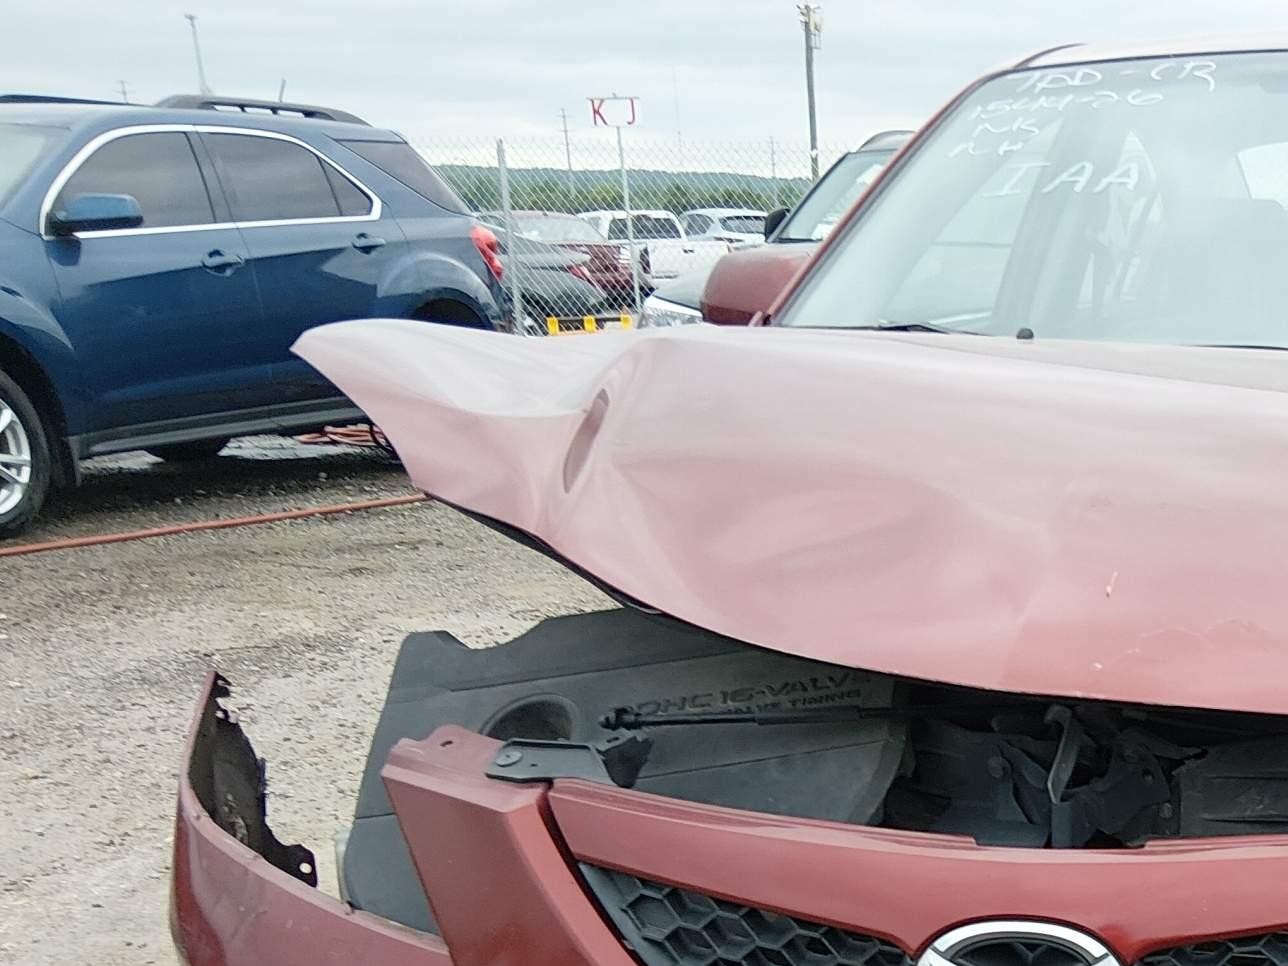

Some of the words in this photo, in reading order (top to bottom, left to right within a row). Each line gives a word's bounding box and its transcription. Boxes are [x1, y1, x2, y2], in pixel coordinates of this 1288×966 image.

[591, 98, 610, 127] K
[625, 98, 637, 127] J
[978, 160, 1140, 200] IAA
